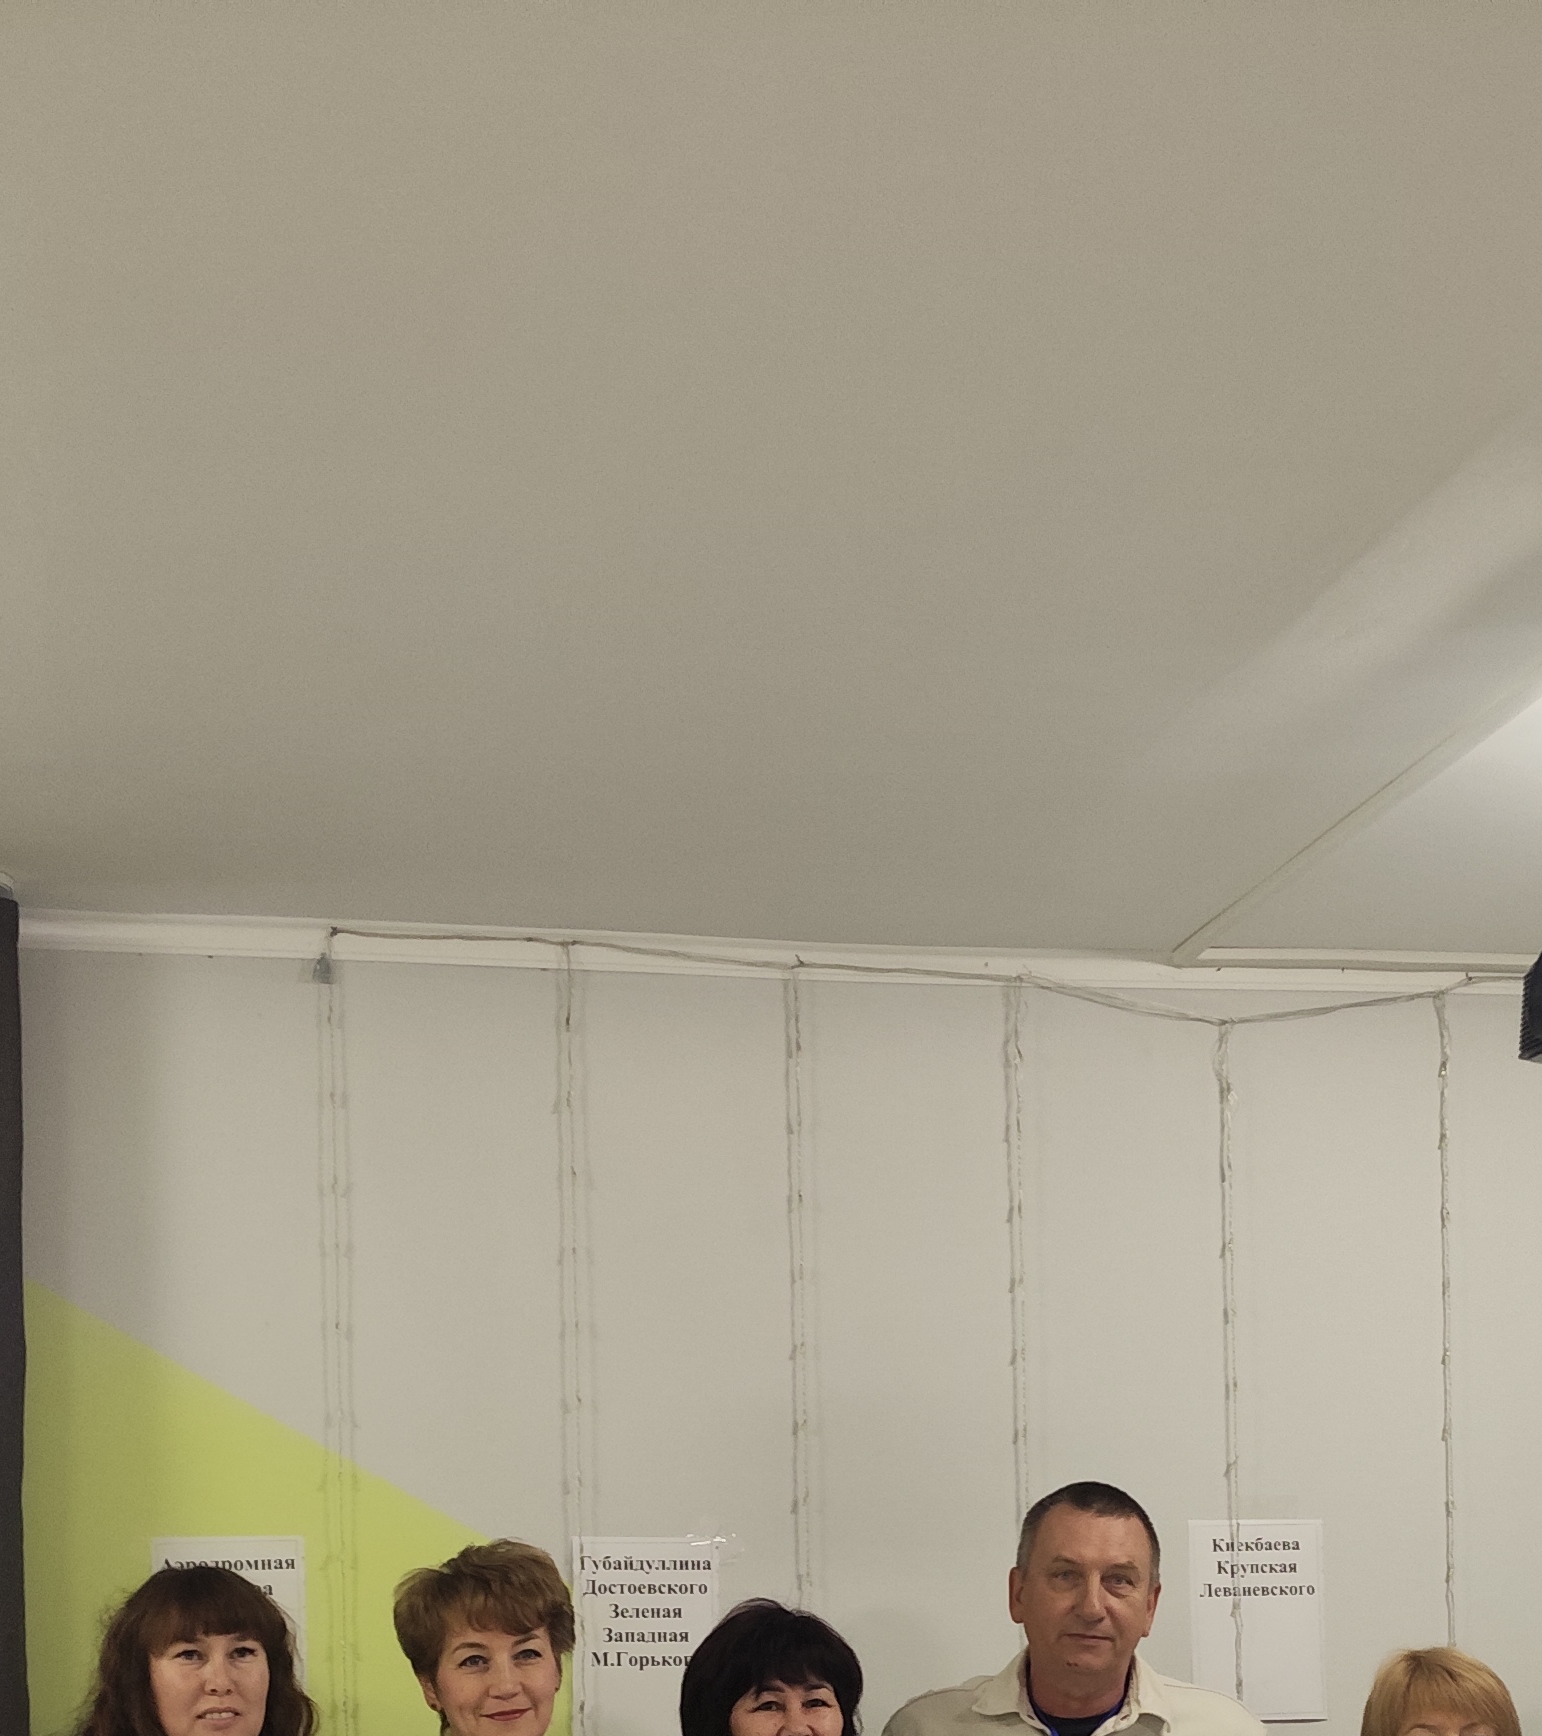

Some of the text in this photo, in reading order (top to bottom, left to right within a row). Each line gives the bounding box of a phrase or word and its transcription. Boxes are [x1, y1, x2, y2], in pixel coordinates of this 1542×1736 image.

[1212, 1537, 1300, 1552] Киекбаева
[580, 1555, 712, 1574] Губайдуллина
[1216, 1560, 1297, 1578] Крупская
[582, 1579, 708, 1597] Достоевского
[1199, 1583, 1315, 1597] Леваневского
[609, 1603, 683, 1619] Зеленая
[602, 1627, 689, 1643] Западная
[591, 1651, 693, 1671] М.Горьког
